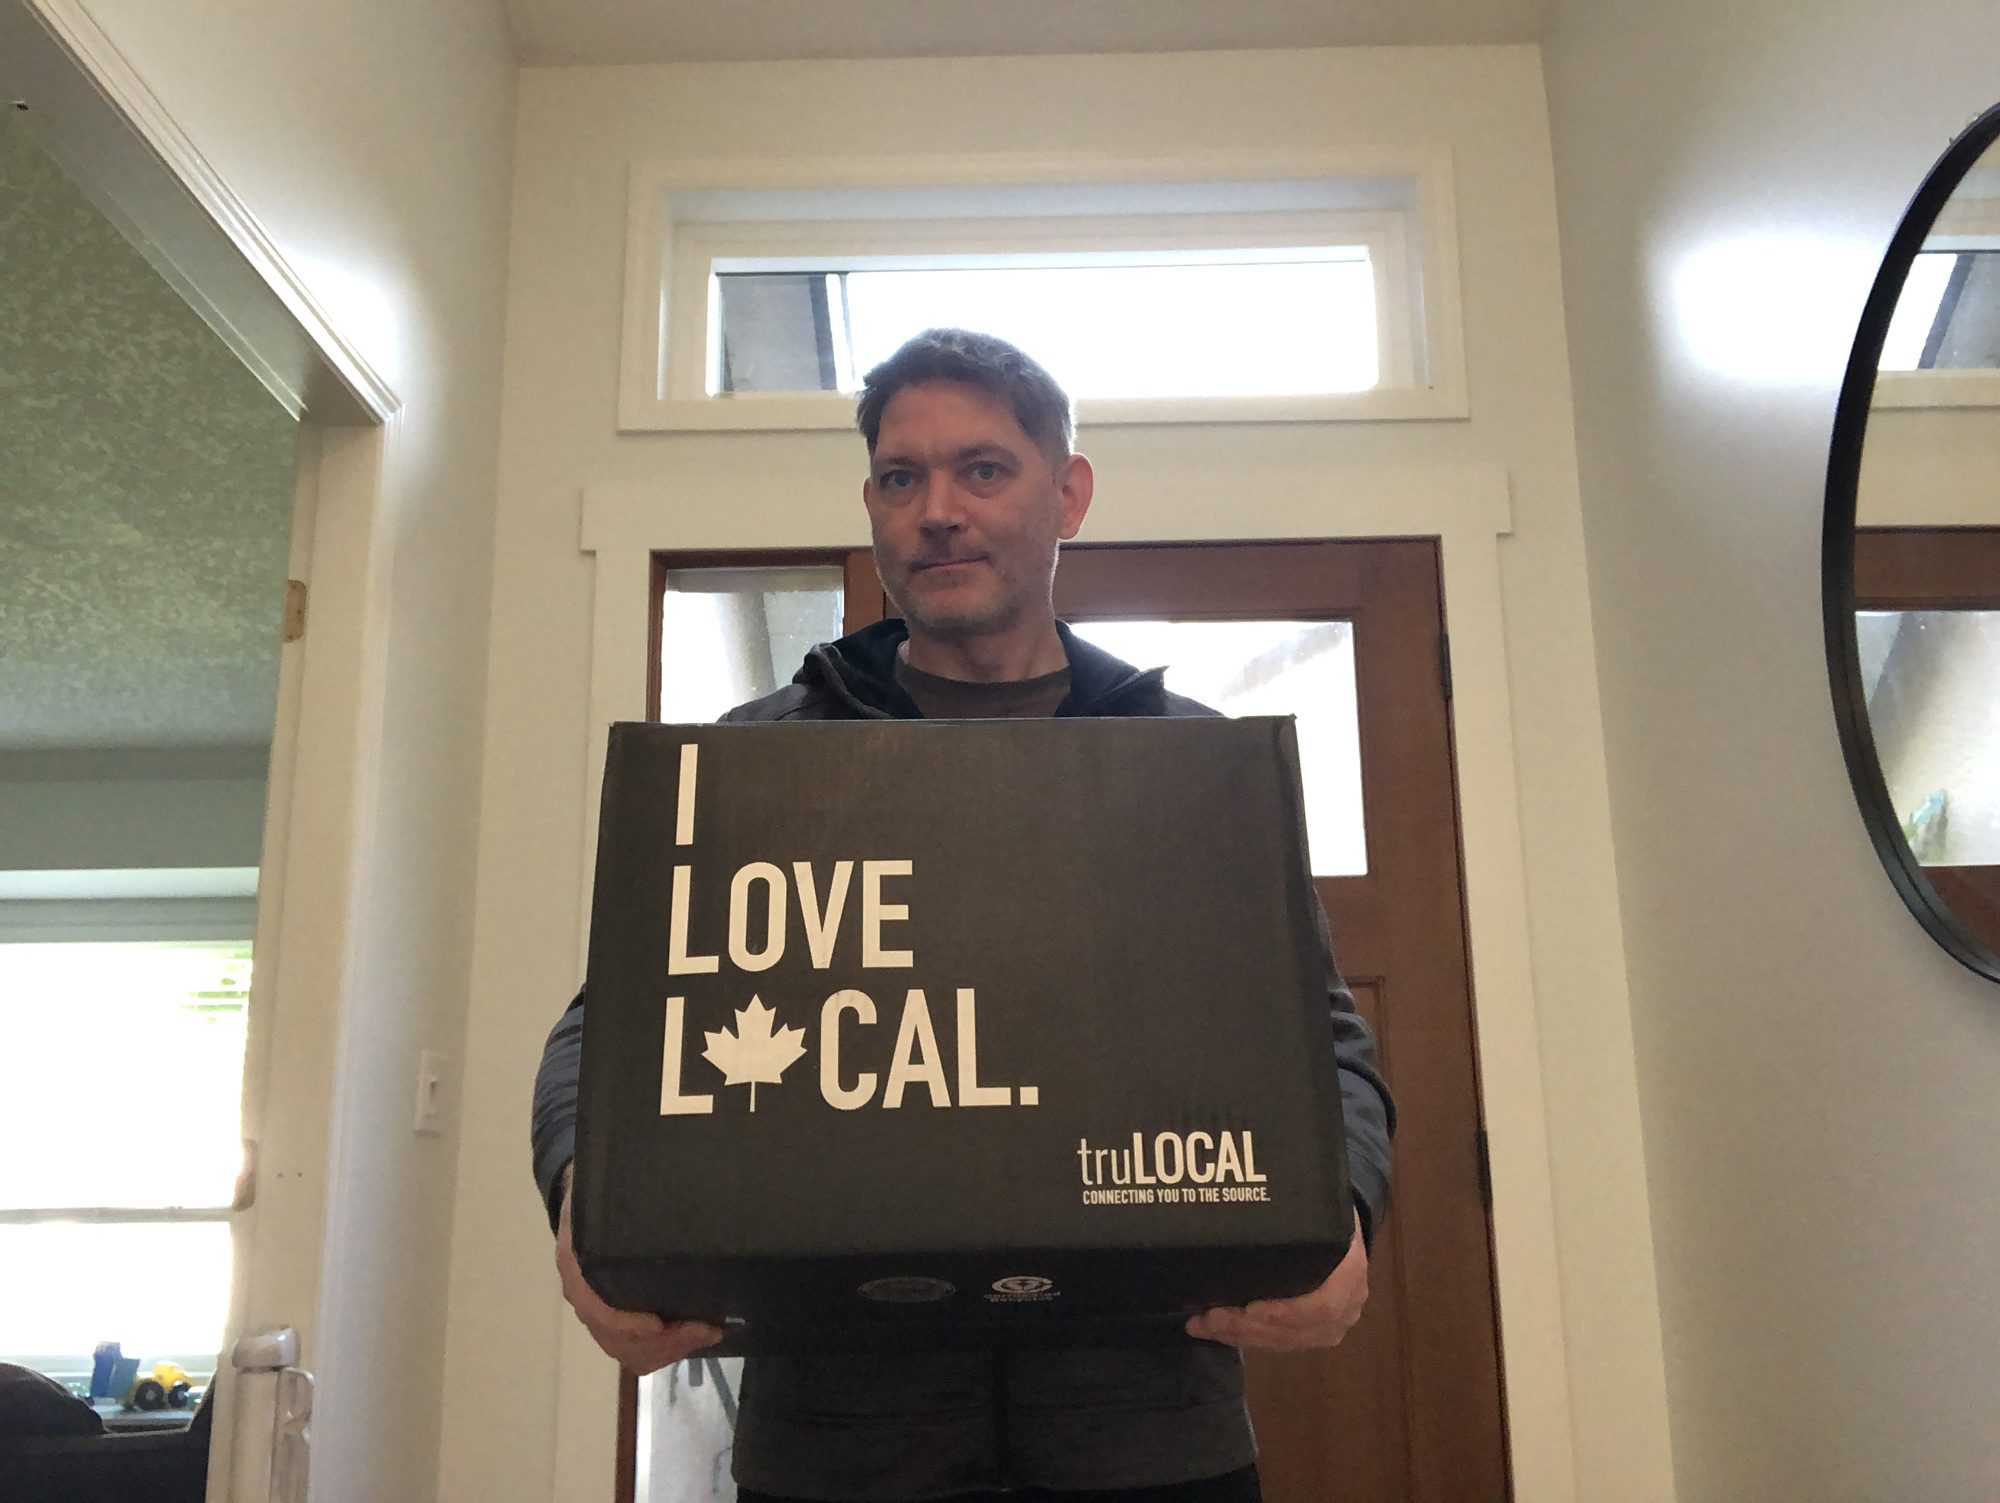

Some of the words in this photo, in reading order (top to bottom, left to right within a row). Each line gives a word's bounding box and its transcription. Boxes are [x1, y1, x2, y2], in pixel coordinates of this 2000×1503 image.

[675, 743, 699, 846] I
[667, 859, 914, 976] LOVE
[659, 987, 1039, 1116] LCAL.
[1077, 1130, 1268, 1186] truLOCAL
[1082, 1188, 1155, 1205] CONNECTING
[1156, 1188, 1180, 1204] YOU
[1180, 1188, 1197, 1203] TO
[1198, 1187, 1220, 1203] THE
[1221, 1186, 1271, 1203] SOURCE.
